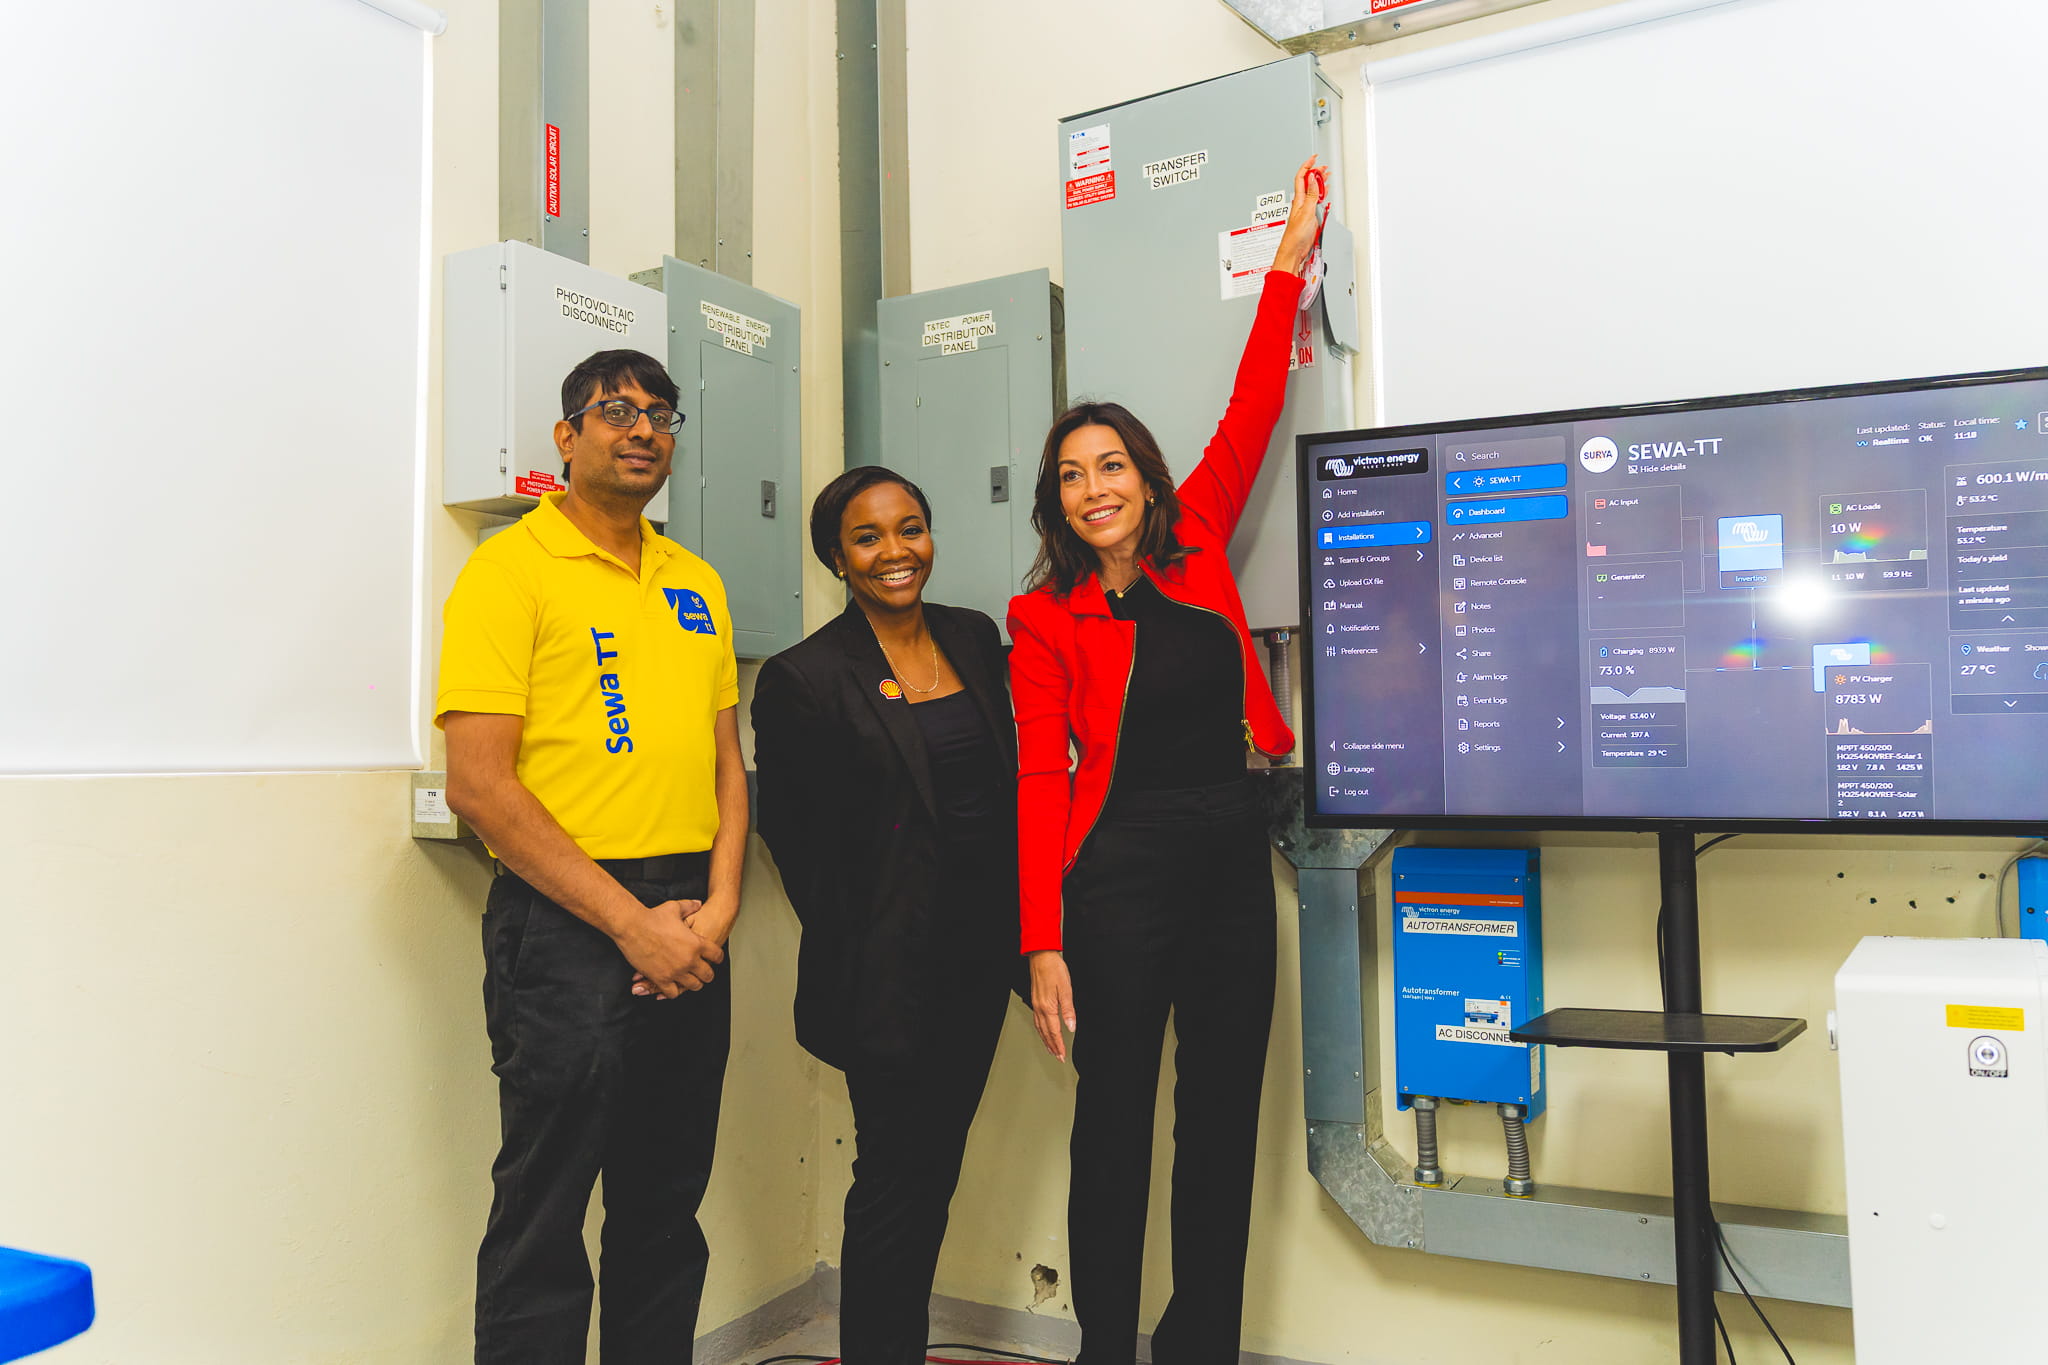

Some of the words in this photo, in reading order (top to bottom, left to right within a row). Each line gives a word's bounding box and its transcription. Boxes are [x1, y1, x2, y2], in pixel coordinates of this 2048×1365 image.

[549, 126, 557, 155] CIRCUIT
[549, 156, 557, 181] SOLAR
[1145, 152, 1207, 176] TRANSFER
[1074, 174, 1106, 188] WARNING
[1153, 168, 1198, 188] SWITCH
[549, 182, 557, 214] CAUTION
[1259, 193, 1283, 207] GRID
[1254, 206, 1289, 222] POWER
[556, 287, 635, 323] PHOTOVOLTAIC
[562, 304, 628, 335] DISCONNECT
[702, 303, 741, 324] RENEWABLE
[746, 318, 769, 333] ENERGY
[927, 320, 951, 331] T&TEC
[962, 313, 990, 325] POWER
[708, 318, 765, 346] DISTRIBUTION
[924, 324, 994, 346] DISTRIBUTION
[725, 336, 752, 354] PANEL
[944, 340, 976, 354] PANEL
[1298, 346, 1313, 364] ON
[1918, 421, 1946, 430] Status:
[1953, 418, 1977, 427] Local
[1978, 416, 2000, 425] time:
[1856, 427, 1873, 435] Last
[1874, 424, 1911, 434] updated:
[1918, 434, 1933, 443] OK
[1953, 431, 1977, 440] 11:18
[1872, 437, 1910, 446] Realtime
[1583, 449, 1613, 460] SURYA
[1628, 438, 1723, 461] SEWA-TT
[1353, 456, 1384, 466] victron
[1386, 453, 1420, 463] energy
[1471, 451, 1500, 460] Search
[1640, 464, 1659, 473] Hide
[1660, 463, 1687, 472] details
[1489, 475, 1521, 485] SEWA-TT
[1976, 472, 2013, 485] 600.1
[527, 480, 556, 490] PHOTOVOLTAIC
[1620, 498, 1639, 507] Input
[1968, 495, 1987, 503] 53.2
[1468, 507, 1506, 516] Dashboard
[1858, 503, 1881, 511] Loads
[1351, 509, 1385, 517] installation
[1831, 524, 1846, 534] 10
[1849, 523, 1862, 533] W
[1957, 524, 2007, 534] Temperature
[1338, 533, 1374, 541] Installations
[1468, 531, 1503, 540] Advanced
[1975, 536, 1986, 544] °C
[1366, 555, 1390, 563] Groups
[1957, 555, 1987, 565] Today's
[1988, 554, 2008, 564] yield
[1470, 579, 1497, 587] Remote
[1498, 577, 1527, 585] Console
[1610, 573, 1646, 581] Generator
[1735, 574, 1768, 583] Inverting
[1339, 579, 1362, 587] Upload
[1958, 585, 1975, 593] Last
[1976, 584, 2010, 594] updated
[1965, 596, 1994, 605] minute
[1995, 596, 2011, 604] ago
[683, 611, 709, 621] sewa
[704, 622, 713, 632] tt
[1340, 624, 1380, 632] Notifications
[1471, 626, 1496, 634] Photos
[590, 627, 618, 666] TT
[1341, 647, 1378, 655] Preferences
[1976, 645, 2011, 653] Weather
[1612, 648, 1644, 656] Charging
[1599, 665, 1623, 675] 73.0
[1625, 665, 1635, 675] %
[1960, 665, 1978, 675] 27
[1979, 664, 1996, 675] °C
[1472, 673, 1493, 681] Alarm
[1493, 673, 1508, 682] logs
[1862, 675, 1893, 684] Charger
[1493, 697, 1508, 705] logs
[1835, 694, 1866, 704] 8783
[1868, 693, 1882, 703] W
[600, 673, 633, 754] Sewa
[1600, 713, 1626, 721] Voltage
[1473, 720, 1500, 729] Reports
[1343, 742, 1371, 750] Collapse
[1371, 742, 1385, 750] side
[1474, 744, 1501, 752] Settings
[1860, 744, 1893, 752] 450/200
[1601, 750, 1644, 758] Temperature
[1343, 766, 1375, 774] Language
[1861, 782, 1894, 790] 450/200
[1344, 788, 1356, 796] Log
[1406, 921, 1515, 934] AUTOTRANSFORMER
[1402, 986, 1460, 997] Autotransformer
[1438, 1028, 1453, 1038] AC
[1455, 1029, 1523, 1044] DISCONNE
